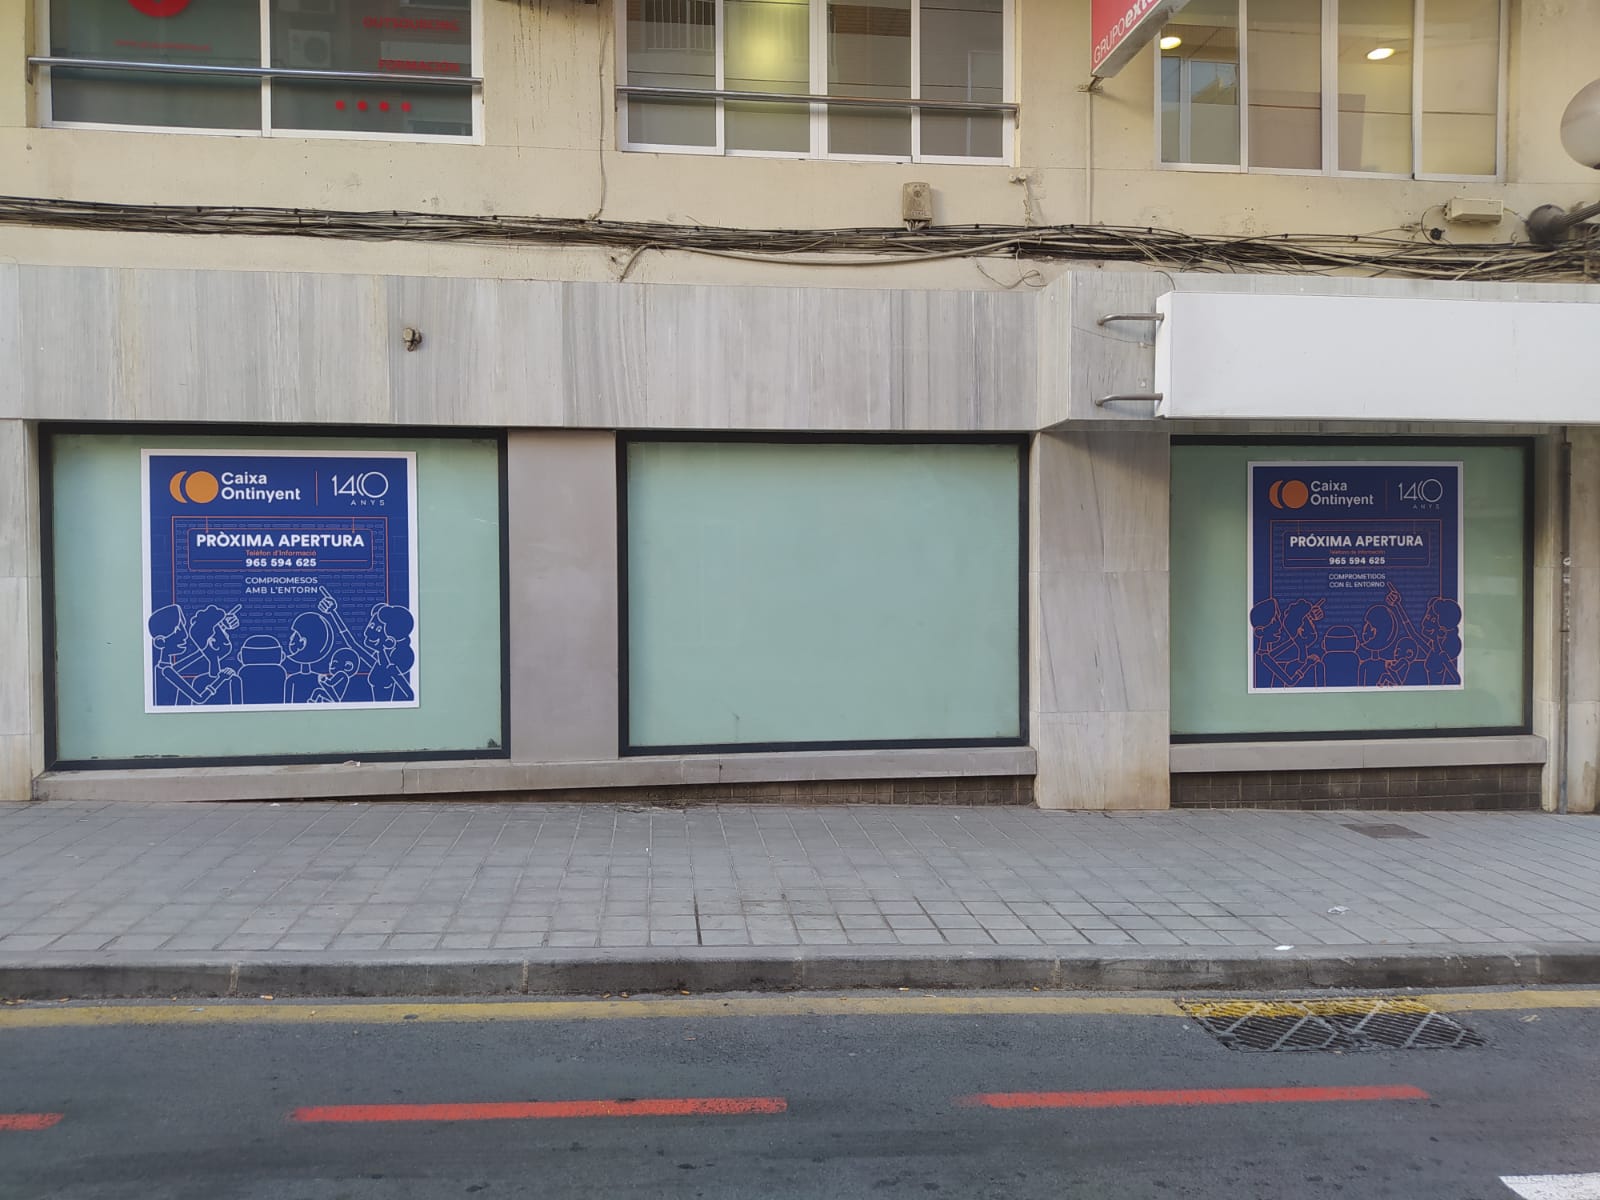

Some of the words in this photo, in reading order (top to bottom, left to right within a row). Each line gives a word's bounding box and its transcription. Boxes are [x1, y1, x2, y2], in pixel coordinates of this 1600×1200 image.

[1093, 0, 1153, 64] GRUPOex
[221, 471, 268, 485] Caixa
[1310, 480, 1348, 492] Caixa
[221, 486, 301, 503] Ontinyent
[1310, 493, 1374, 508] Ontinyent
[196, 531, 275, 547] PRÒXIMA
[278, 534, 365, 547] APERTURA
[1290, 533, 1352, 547] PRÓXIMA
[1355, 535, 1424, 547] APERTURA
[245, 558, 267, 567] 965
[270, 558, 292, 567] 594
[295, 558, 317, 567] 625
[1329, 557, 1346, 565] 965
[1349, 556, 1366, 565] 594
[1368, 556, 1386, 565] 625
[245, 576, 318, 584] COMPROMESOS
[245, 586, 267, 594] AMB
[270, 586, 318, 594] L'ENTORN
